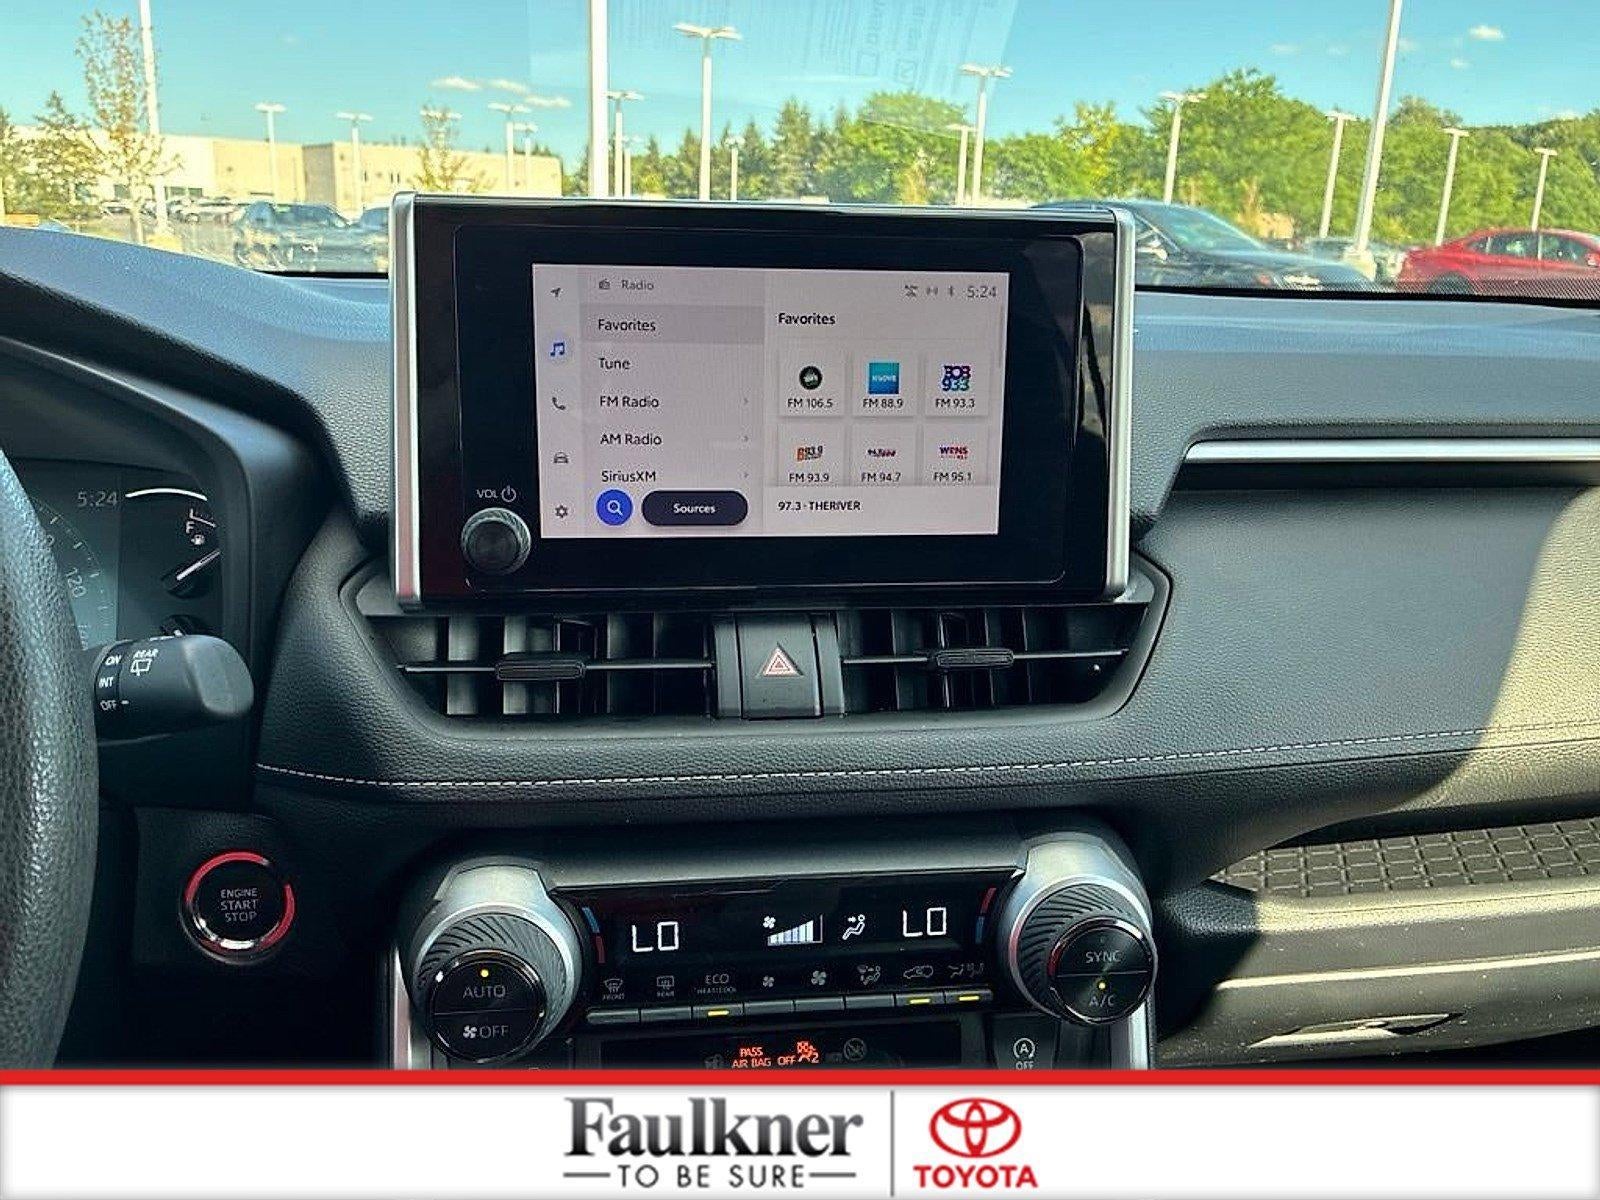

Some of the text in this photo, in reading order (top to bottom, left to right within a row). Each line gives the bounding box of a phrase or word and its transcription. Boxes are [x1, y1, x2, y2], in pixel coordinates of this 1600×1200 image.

[621, 279, 655, 291] Radio
[966, 285, 997, 298] 5:24
[778, 312, 836, 325] Favorites
[598, 318, 656, 332] Favorites
[599, 357, 631, 370] Tune
[600, 395, 660, 408] FM Radio
[787, 398, 833, 409] FM 106.5
[863, 398, 903, 409] FM 88.9
[935, 398, 975, 408] FM 93.3
[600, 433, 662, 445] AM Radio
[601, 470, 657, 483] SiriusXM
[789, 473, 830, 482] FM 93.9
[861, 473, 901, 482] FM 94.7
[933, 471, 972, 482] FM 95.1
[77, 491, 118, 507] 5:24
[476, 489, 499, 498] VOL
[673, 503, 717, 514] Sources
[778, 501, 861, 511] 97.3 THERIVER
[66, 567, 87, 598] 120
[105, 655, 122, 666] ON
[99, 676, 114, 689] INT
[100, 700, 117, 711] OFF
[220, 888, 259, 899] ENGINE
[220, 900, 259, 911] START
[224, 911, 258, 923] STOP
[1085, 951, 1123, 964] SYNC
[704, 973, 730, 985] ECO
[462, 985, 506, 999] AUTO
[479, 1025, 510, 1039] OFF
[739, 1046, 764, 1057] PASS
[731, 1059, 748, 1069] AIR
[751, 1056, 772, 1069] BAG
[777, 1054, 796, 1067] OFF
